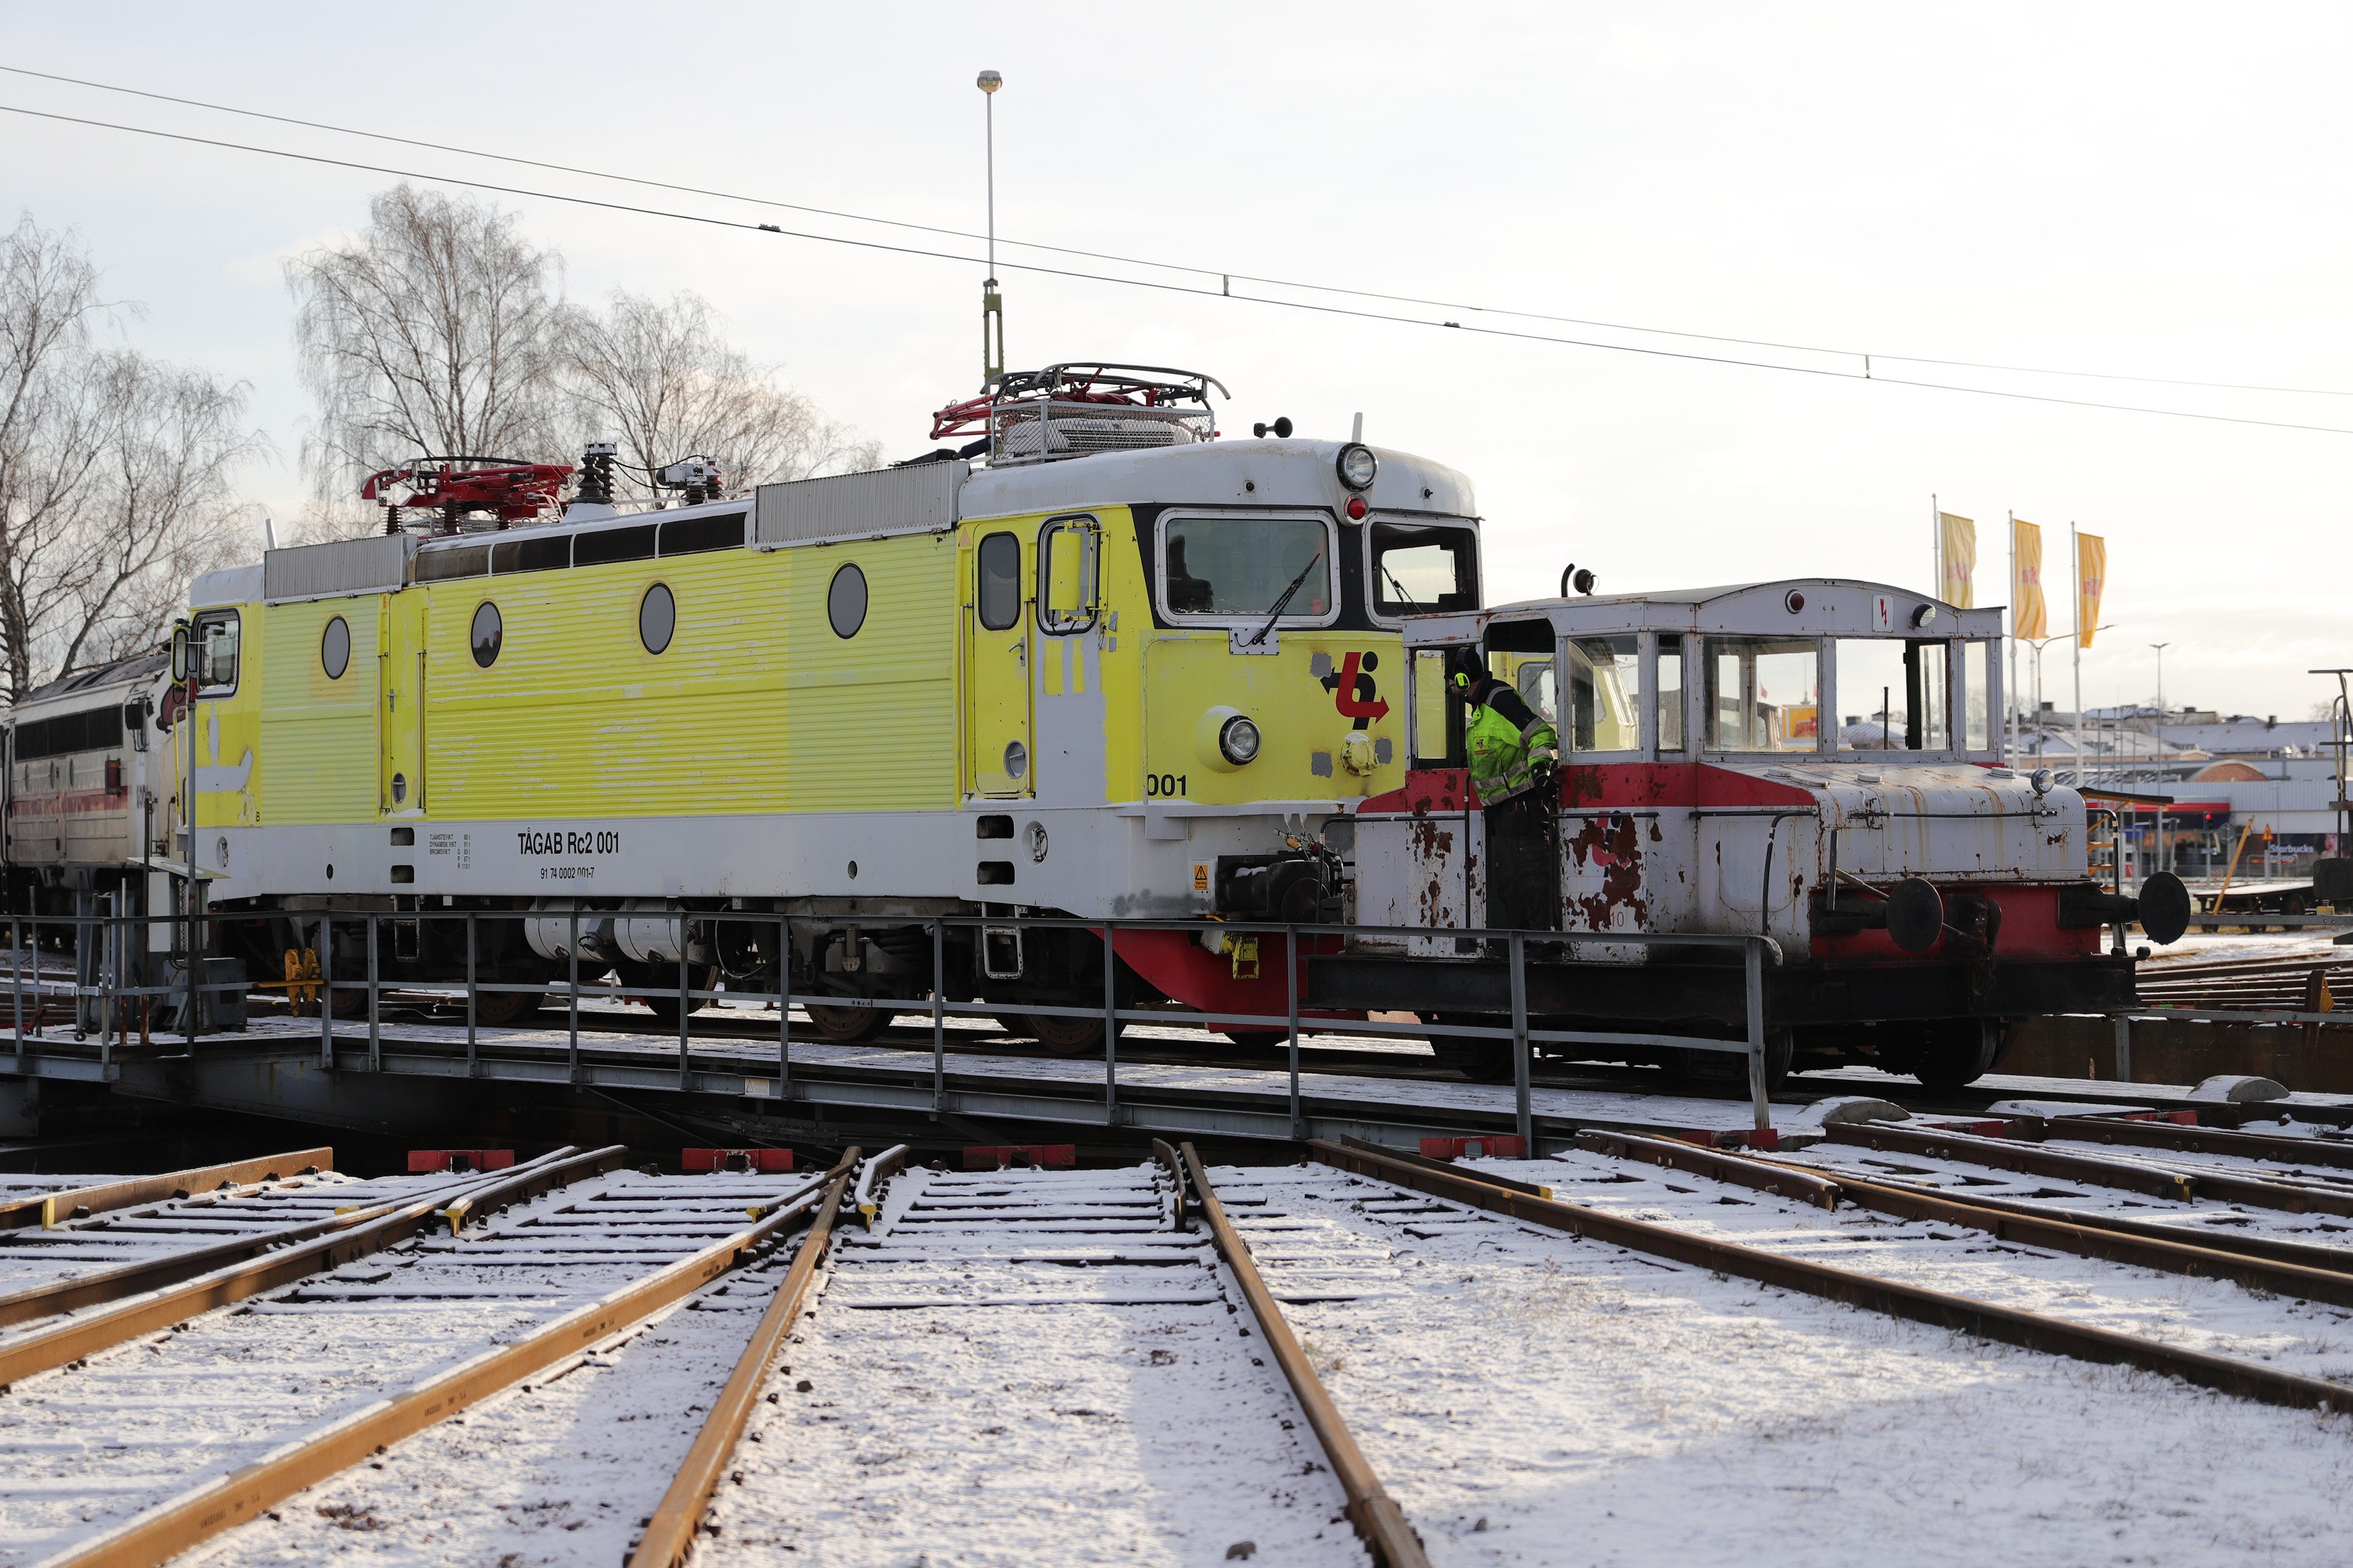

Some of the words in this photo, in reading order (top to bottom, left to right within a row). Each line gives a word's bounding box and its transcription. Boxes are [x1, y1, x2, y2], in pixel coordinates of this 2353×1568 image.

[1147, 774, 1186, 796] 001
[518, 827, 563, 855] TÅGAB
[567, 831, 592, 854] Rc2
[596, 831, 619, 854] 001
[541, 868, 548, 879] 91
[550, 868, 557, 879] 74
[559, 867, 575, 879] 0002
[577, 867, 594, 878] 001-7
